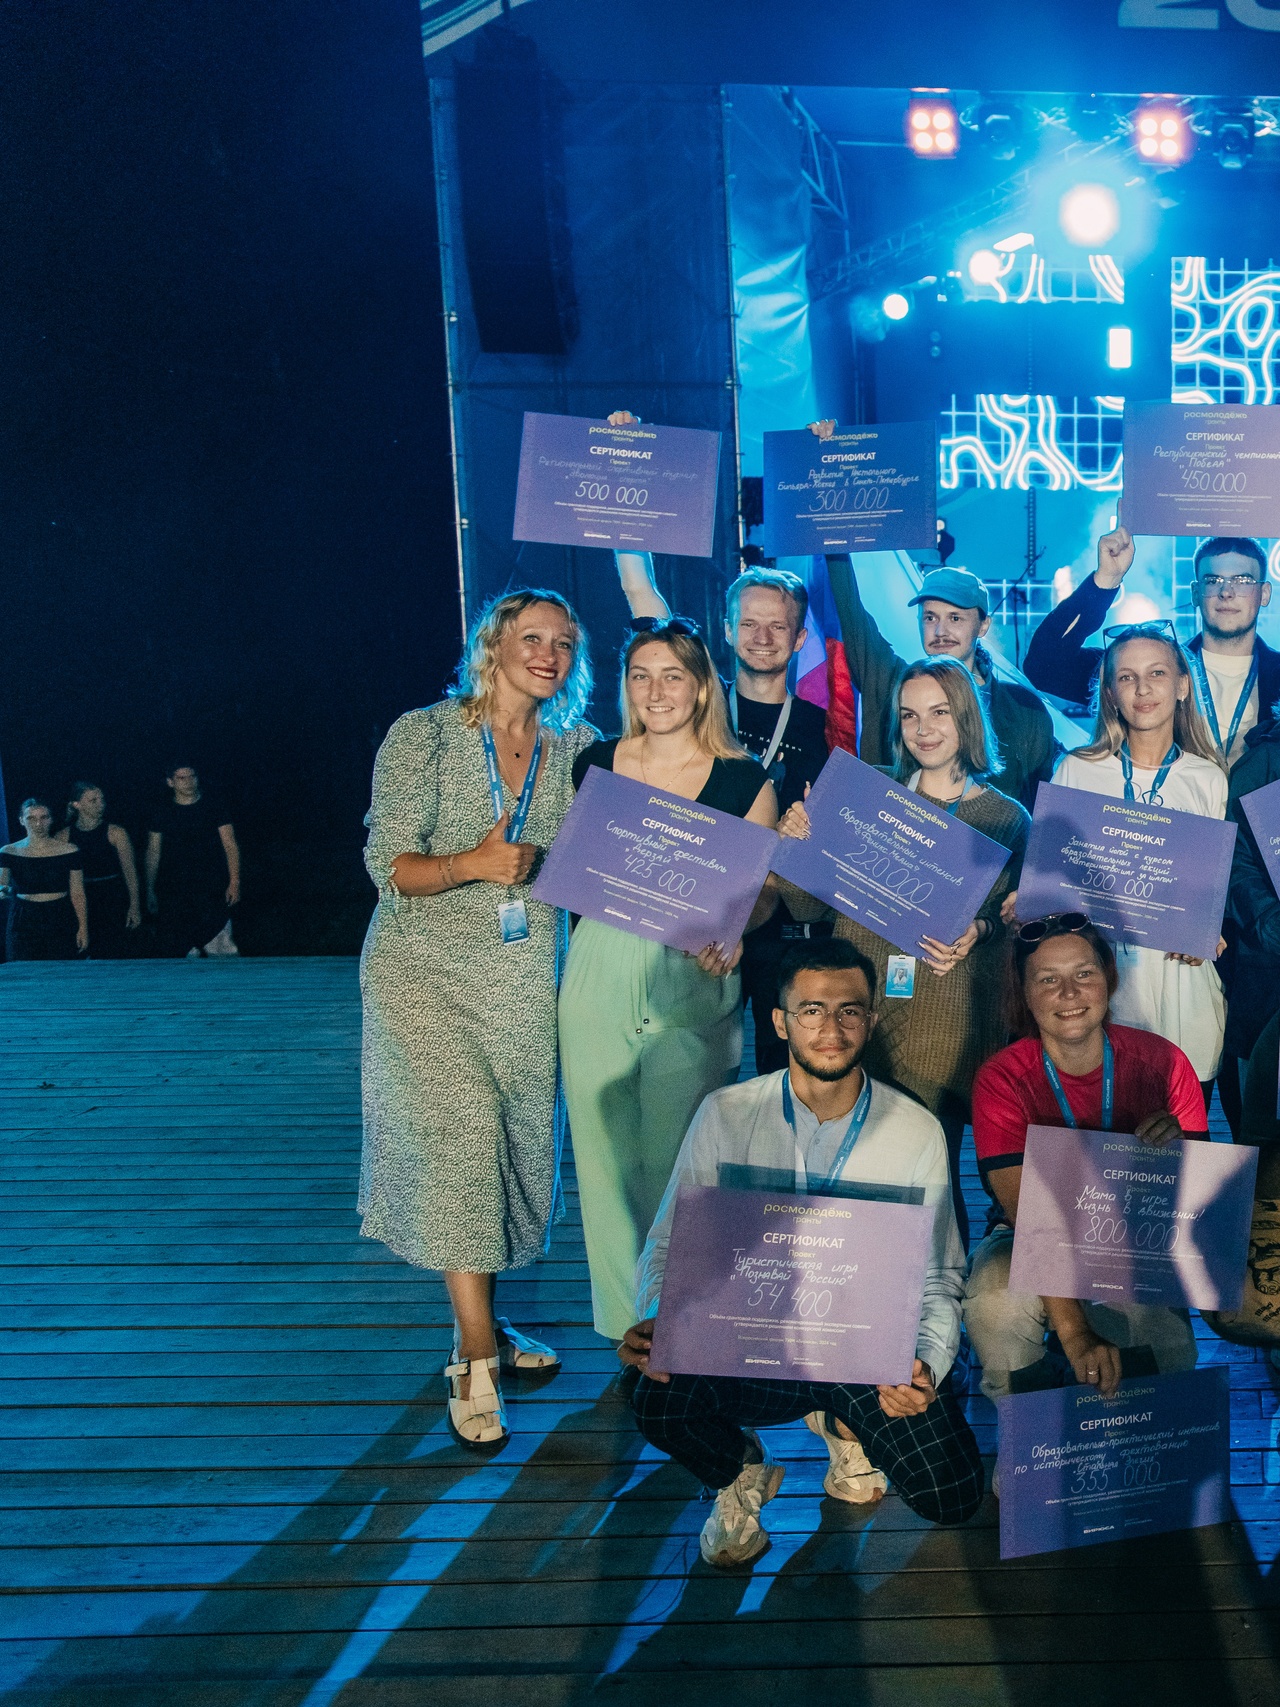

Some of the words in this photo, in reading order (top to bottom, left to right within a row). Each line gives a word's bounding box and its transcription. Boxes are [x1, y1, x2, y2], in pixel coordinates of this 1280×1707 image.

[1185, 432, 1245, 442] СЕРТИФИКАТ
[589, 446, 653, 460] СЕРТИФИКАТ
[821, 452, 876, 463] СЕРТИФИКАТ
[1153, 445, 1228, 462] Республиканский
[575, 481, 610, 501] 500
[616, 486, 649, 506] 000
[1181, 469, 1211, 491] 450
[1212, 472, 1247, 493] 000
[808, 489, 847, 512] 300
[854, 486, 890, 510] 000
[642, 817, 706, 846] СЕРТИФИКАТ
[878, 810, 936, 849] СЕРТИФИКАТ
[1102, 826, 1166, 847] СЕРТИФИКАТ
[606, 820, 667, 851] Спортивный
[673, 849, 727, 873] фестиваль
[838, 806, 920, 859] Образовательный
[919, 859, 964, 886] интенсив
[1068, 835, 1105, 852] Занятия
[1143, 855, 1174, 866] курсом
[844, 843, 891, 878] 220
[886, 868, 934, 904] 000
[1060, 846, 1132, 867] образовательных
[1139, 864, 1171, 876] лекций
[625, 854, 662, 878] 425
[658, 869, 696, 897] 000
[1081, 868, 1116, 891] 500
[1124, 879, 1154, 898] 000
[1103, 1169, 1177, 1185] СЕРТИФИКАТ
[1074, 1196, 1111, 1215] Жизнь
[1123, 1201, 1131, 1214] в
[1080, 1185, 1116, 1201] Мама
[1141, 1195, 1169, 1207] игре
[763, 1232, 845, 1249] СЕРТИФИКАТ
[1085, 1215, 1128, 1244] 800
[1135, 1222, 1180, 1252] 000
[733, 1248, 823, 1271] Туристическая
[831, 1264, 859, 1275] игра
[747, 1282, 785, 1310] 54
[791, 1287, 832, 1318] 400
[1080, 1411, 1153, 1431] СЕРТИФИКАТ
[1014, 1464, 1028, 1475] по
[1033, 1453, 1107, 1470] историческому
[1070, 1467, 1112, 1494] 355
[1124, 1461, 1160, 1487] 000
